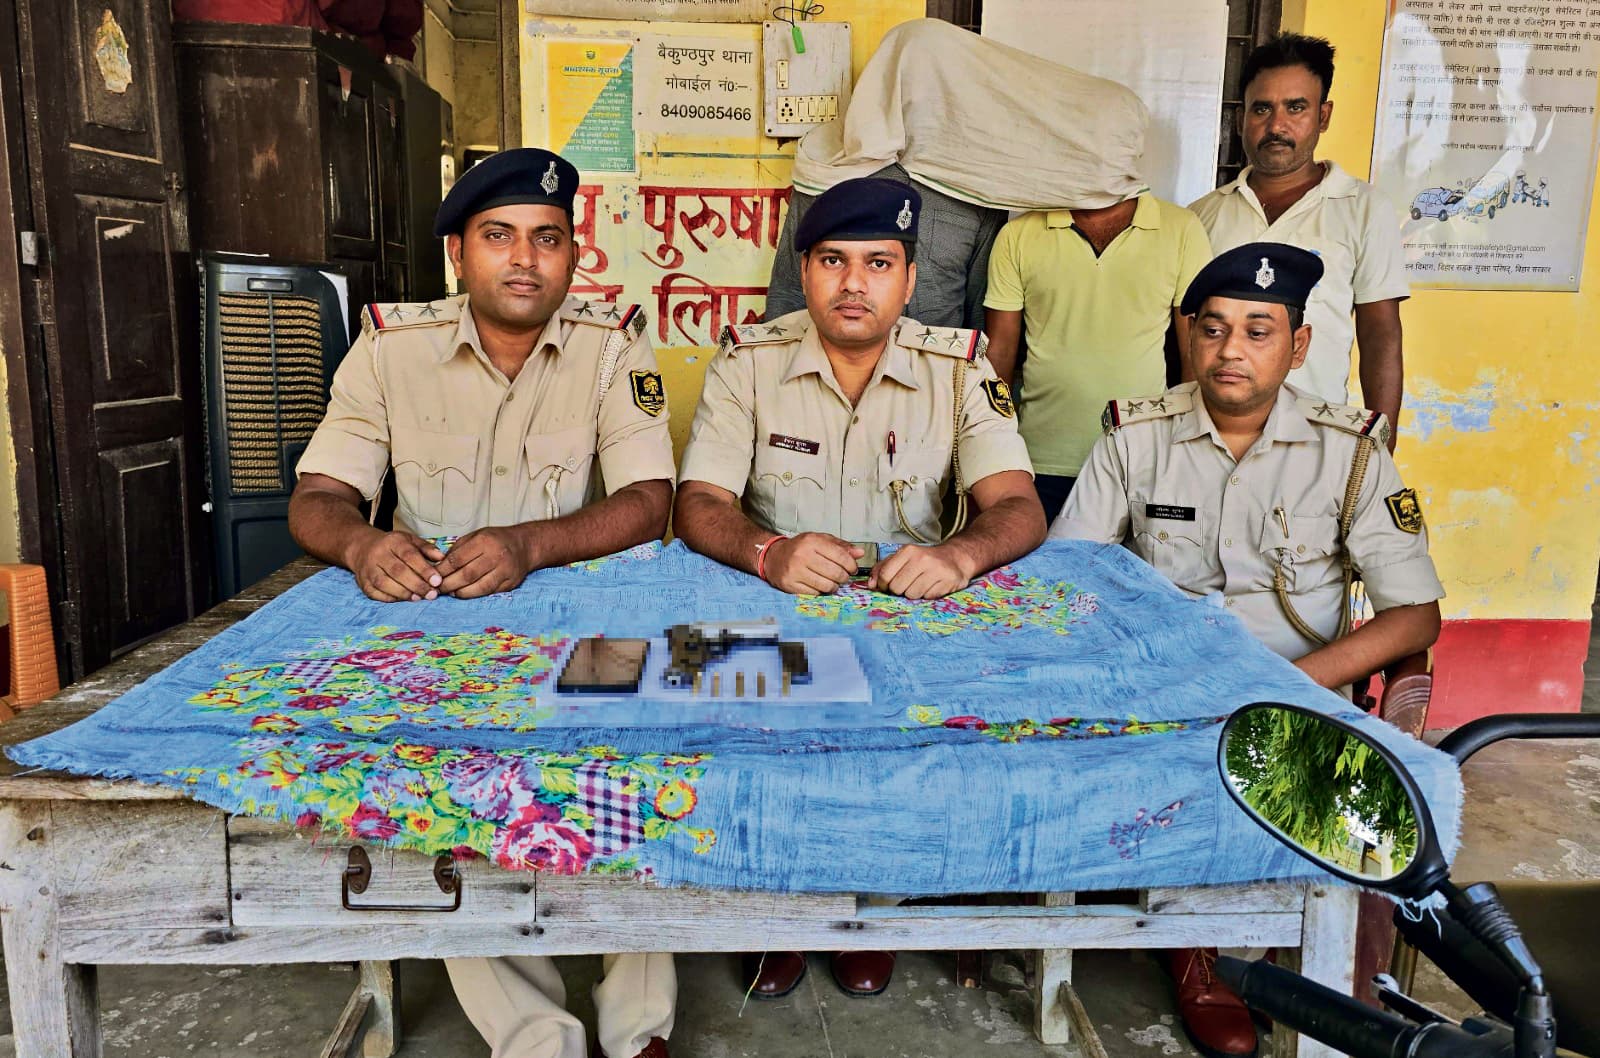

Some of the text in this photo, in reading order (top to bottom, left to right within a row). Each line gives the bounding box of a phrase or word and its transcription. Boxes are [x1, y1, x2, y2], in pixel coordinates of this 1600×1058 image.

[657, 42, 752, 66] बैकुण्ठपुर थाना
[665, 73, 711, 92] मोबाईल
[661, 103, 752, 121] 8409085466
